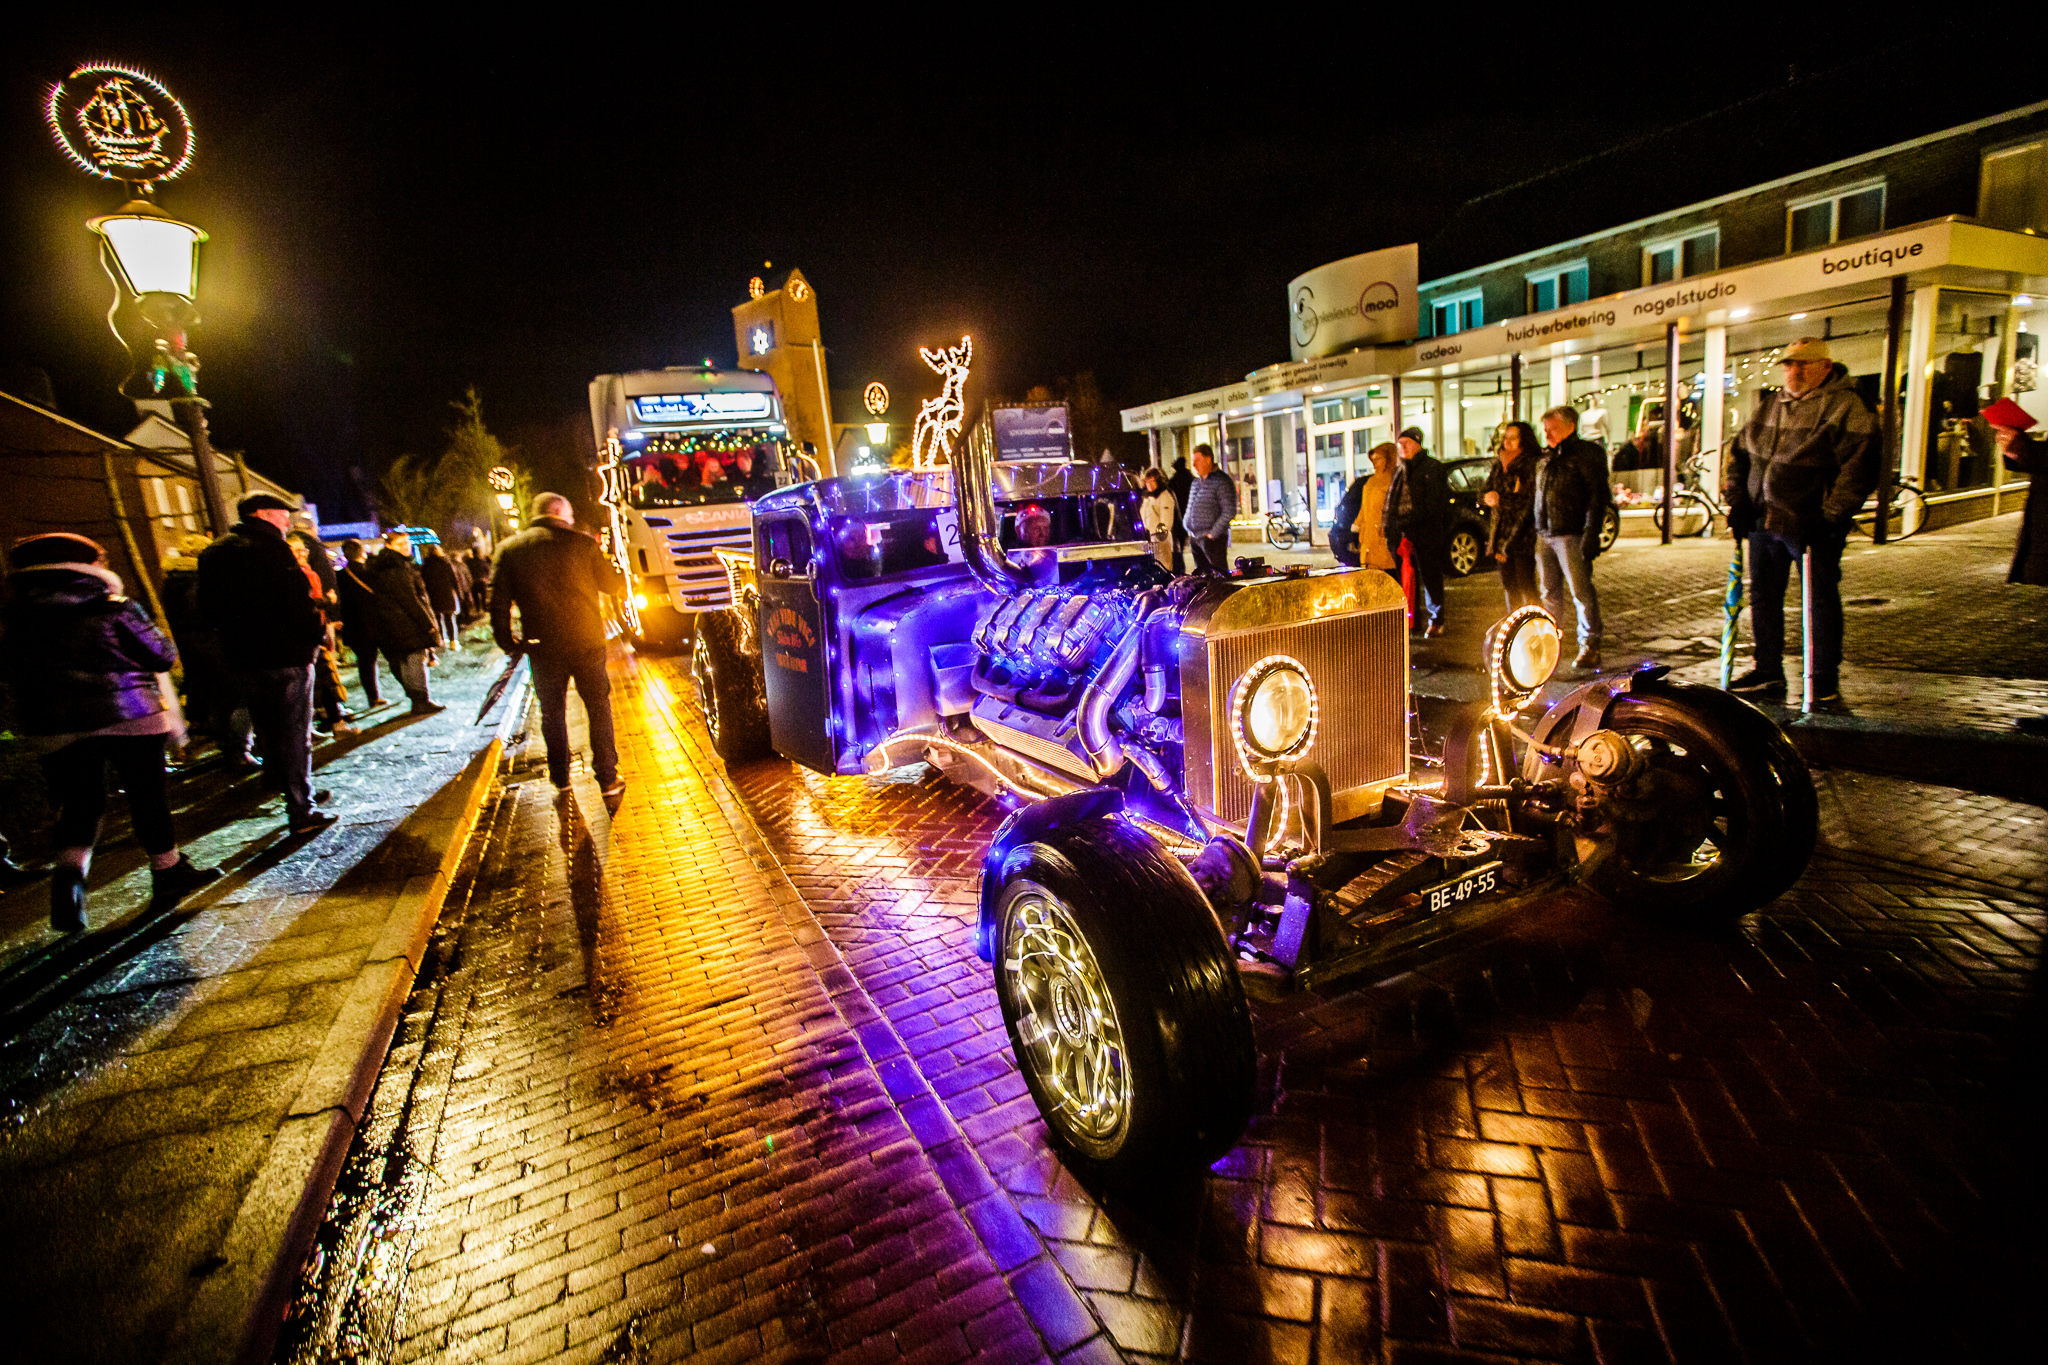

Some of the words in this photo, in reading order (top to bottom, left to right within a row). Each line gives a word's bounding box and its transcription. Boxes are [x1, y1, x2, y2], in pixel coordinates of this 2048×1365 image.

[1823, 240, 1923, 275] boutique
[1365, 298, 1399, 314] mooi
[1633, 281, 1737, 317] nagelstudio
[1506, 308, 1616, 342] huidverbetering
[1420, 343, 1462, 361] cadeau
[1192, 398, 1220, 411] massage
[686, 508, 751, 525] SCANIA
[1430, 871, 1496, 912] BE-49-55
